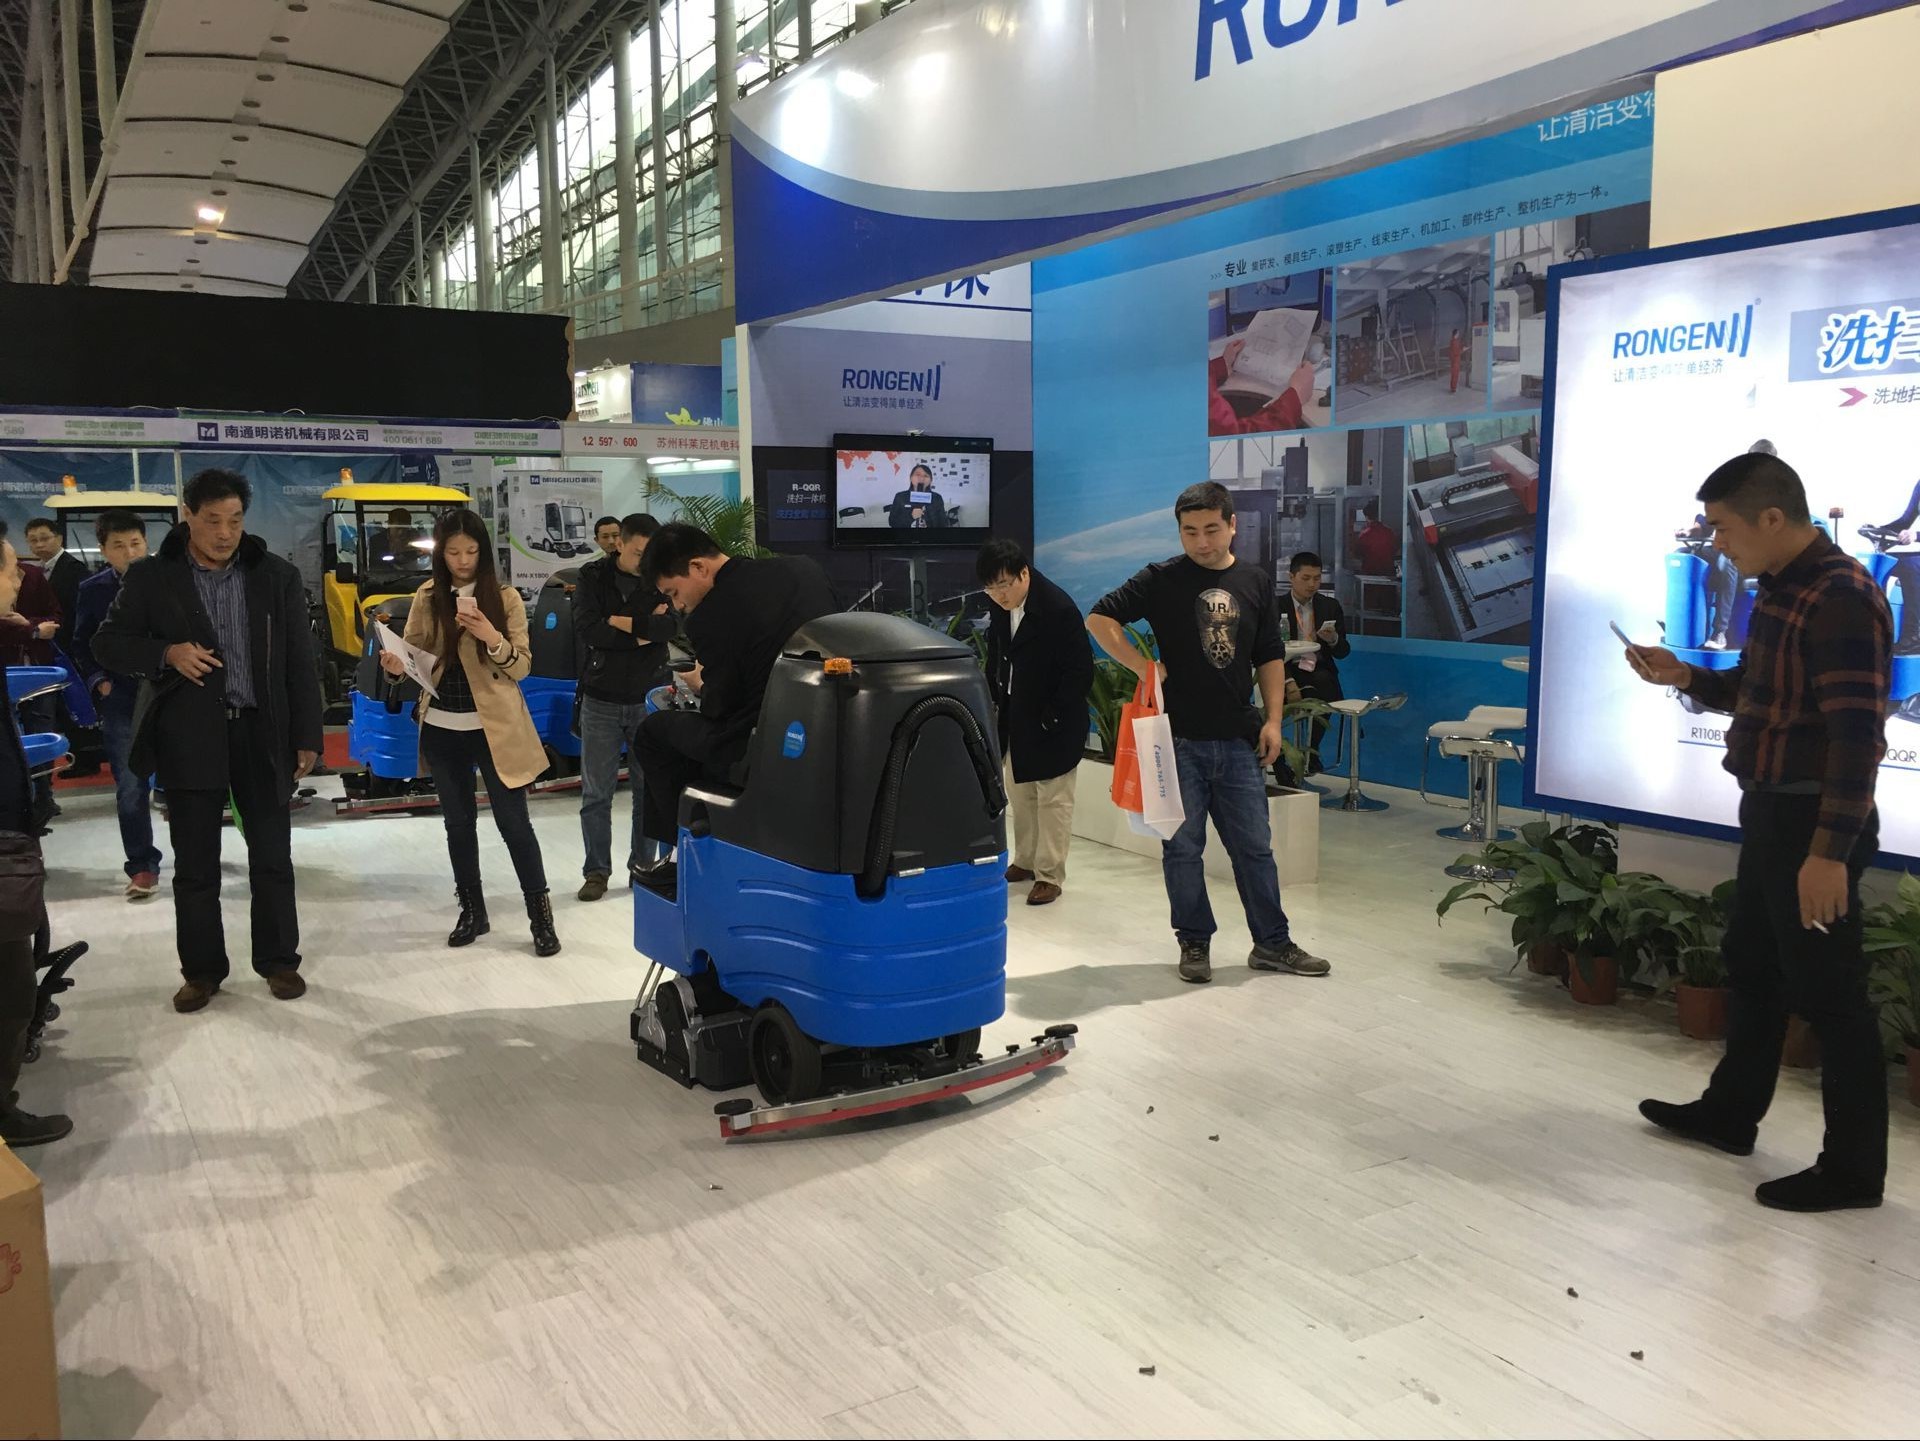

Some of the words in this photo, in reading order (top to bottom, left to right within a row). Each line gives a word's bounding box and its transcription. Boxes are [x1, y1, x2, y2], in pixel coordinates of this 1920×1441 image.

[1224, 258, 1247, 278] 专业
[1613, 318, 1726, 359] RONGEN
[842, 368, 924, 393] RONGEN
[224, 425, 369, 442] 南通明诺机械有限公司
[383, 435, 400, 444] 400
[623, 437, 638, 447] 600
[792, 483, 821, 491] R-QQR
